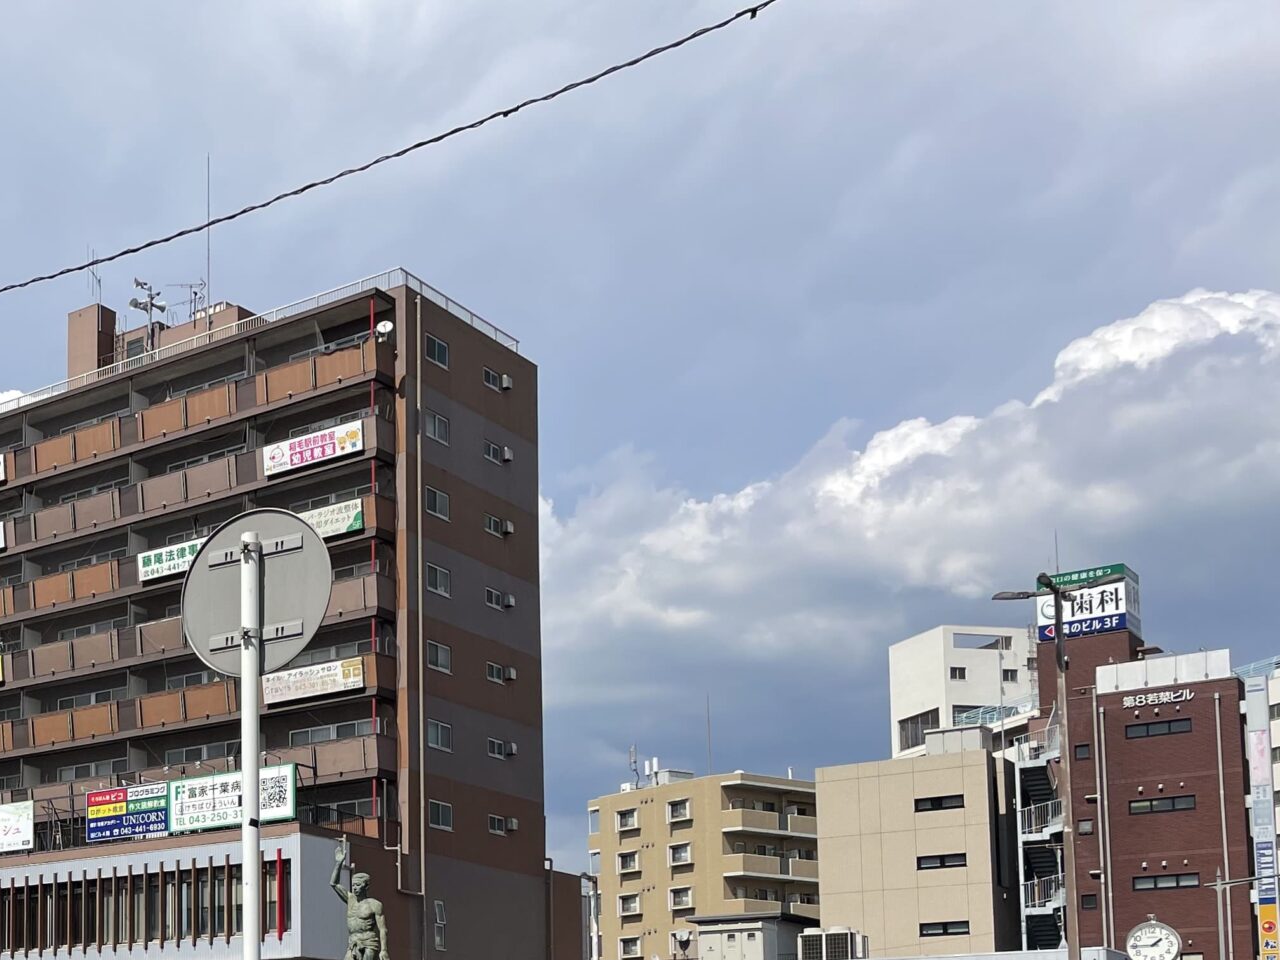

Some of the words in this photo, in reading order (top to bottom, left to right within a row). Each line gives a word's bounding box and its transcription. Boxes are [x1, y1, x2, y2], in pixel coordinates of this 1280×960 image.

[291, 443, 334, 464] 幼児教室
[1104, 616, 1119, 628] 3F
[1122, 689, 1195, 708] 第8若菜ビル
[129, 786, 165, 798] プログラミング
[123, 811, 165, 825] UNICORN
[175, 818, 186, 826] TEL
